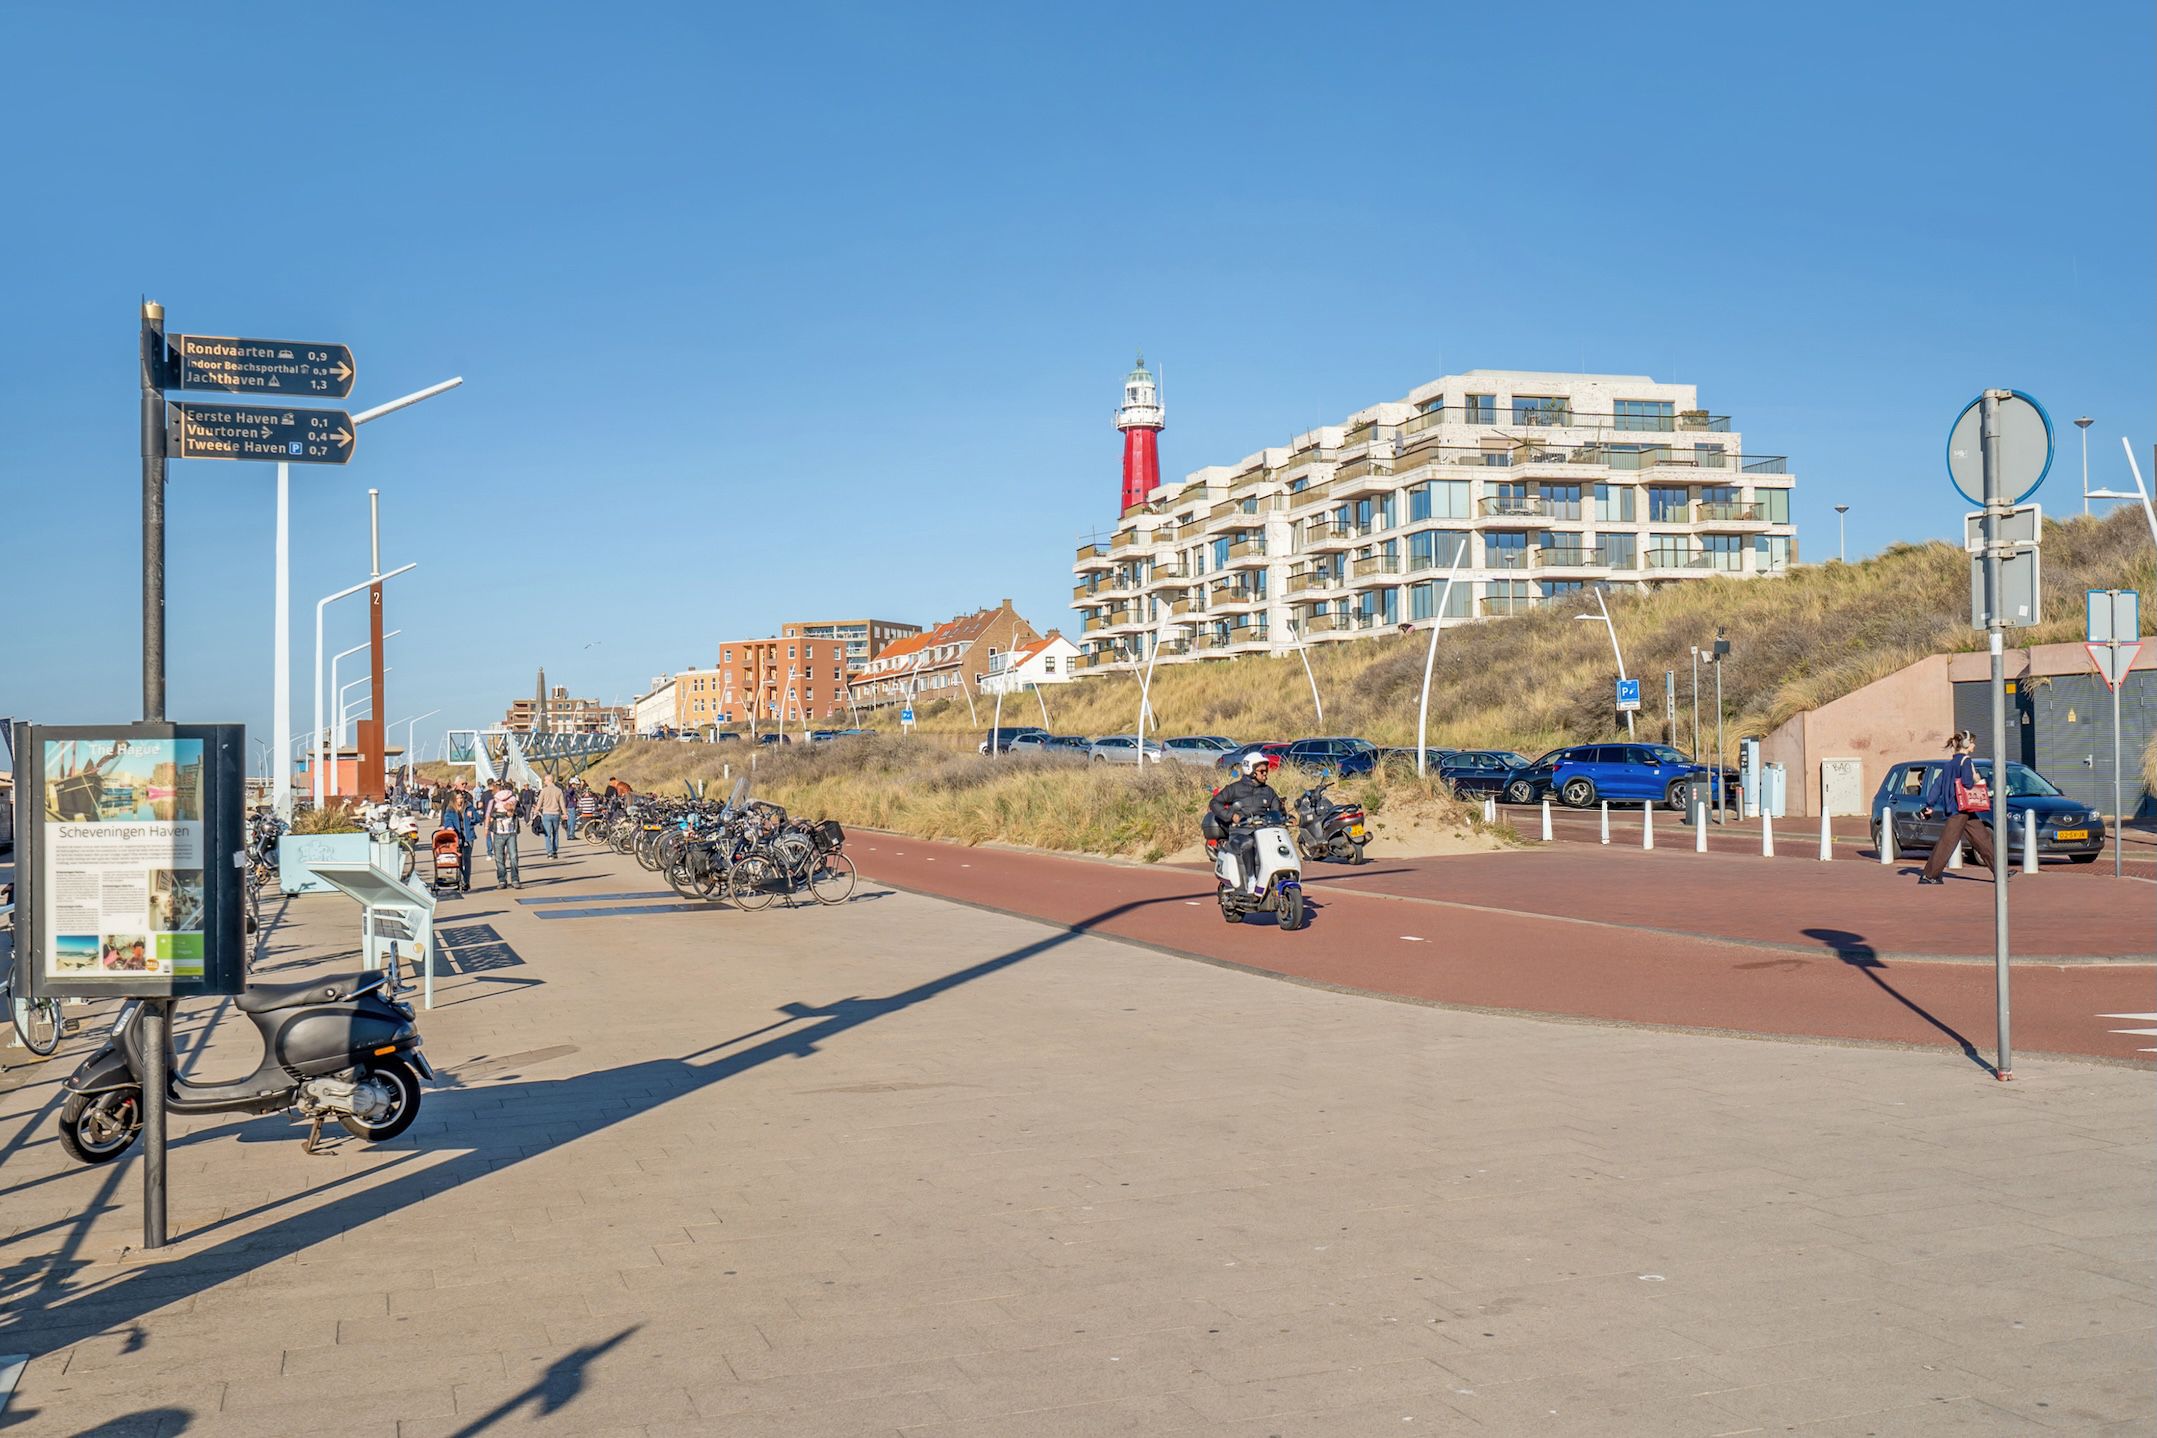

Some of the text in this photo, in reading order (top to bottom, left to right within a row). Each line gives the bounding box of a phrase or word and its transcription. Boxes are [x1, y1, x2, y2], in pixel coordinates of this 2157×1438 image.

[187, 342, 327, 362] Rondvaarten 0,9
[187, 358, 222, 370] Indoor
[224, 361, 299, 374] Beachsporthal
[186, 371, 327, 391] Jachthaven 1,3
[187, 410, 328, 428] Eerste Haven 0,1
[187, 424, 327, 442] Vuurtoren 0,4
[187, 438, 240, 452] Tweede
[244, 441, 286, 454] Haven
[309, 446, 327, 456] 0,7
[373, 592, 380, 605] 2
[1622, 686, 1629, 697] P
[89, 743, 161, 758] The Hague
[59, 826, 189, 841] Scheveningen Haven
